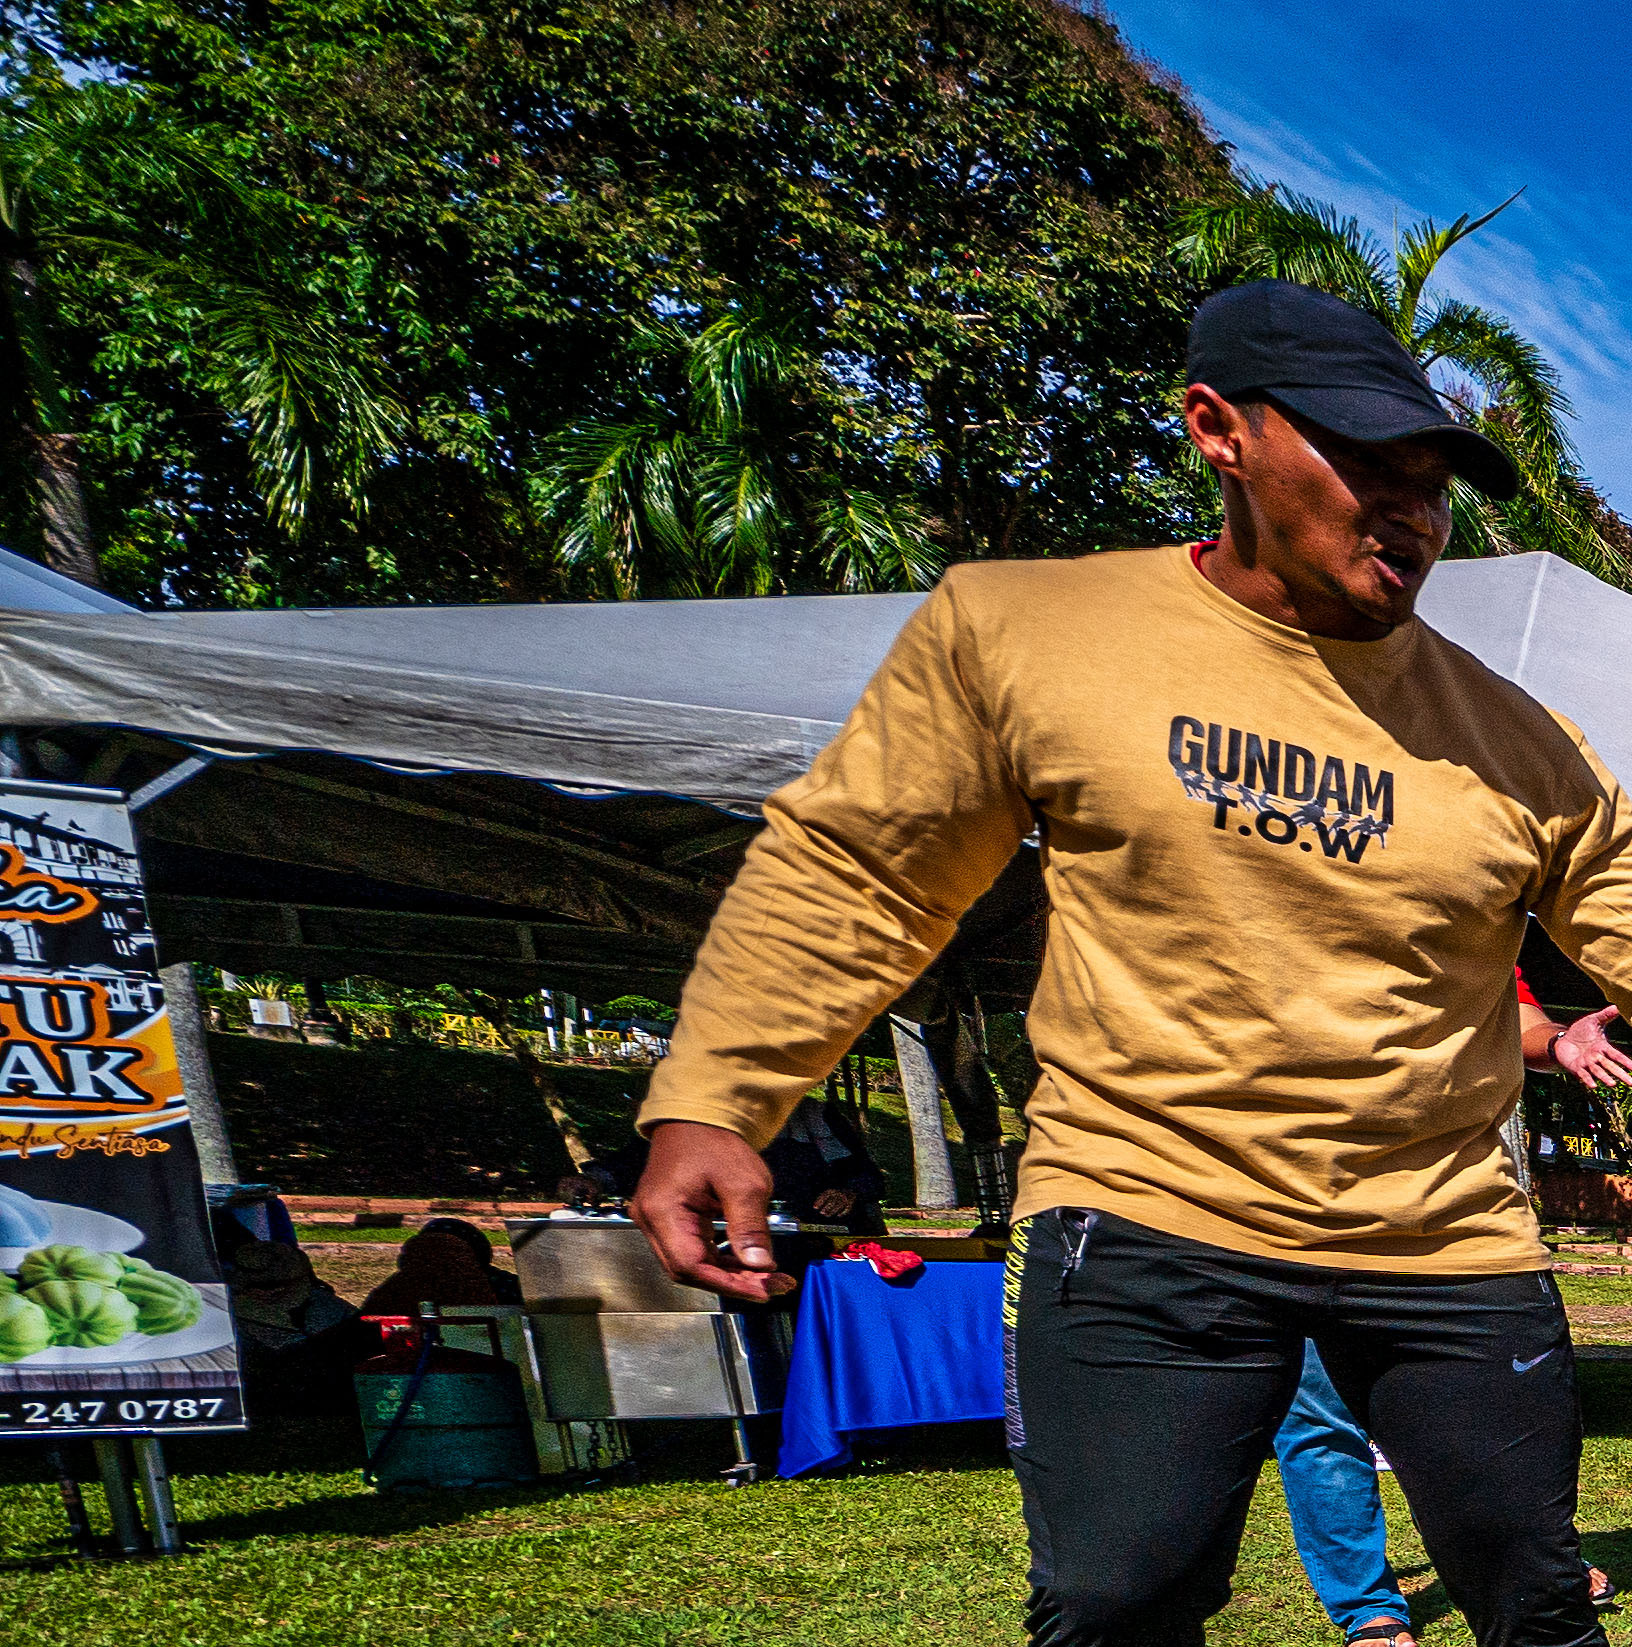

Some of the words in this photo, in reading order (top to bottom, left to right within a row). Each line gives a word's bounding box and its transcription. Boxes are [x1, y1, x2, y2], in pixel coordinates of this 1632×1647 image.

[1168, 715, 1395, 826] GUNDAM
[1206, 793, 1371, 864] T.O.W
[54, 1125, 172, 1159] Sentiasa
[21, 1401, 106, 1424] 247
[118, 1398, 225, 1421] 0787
